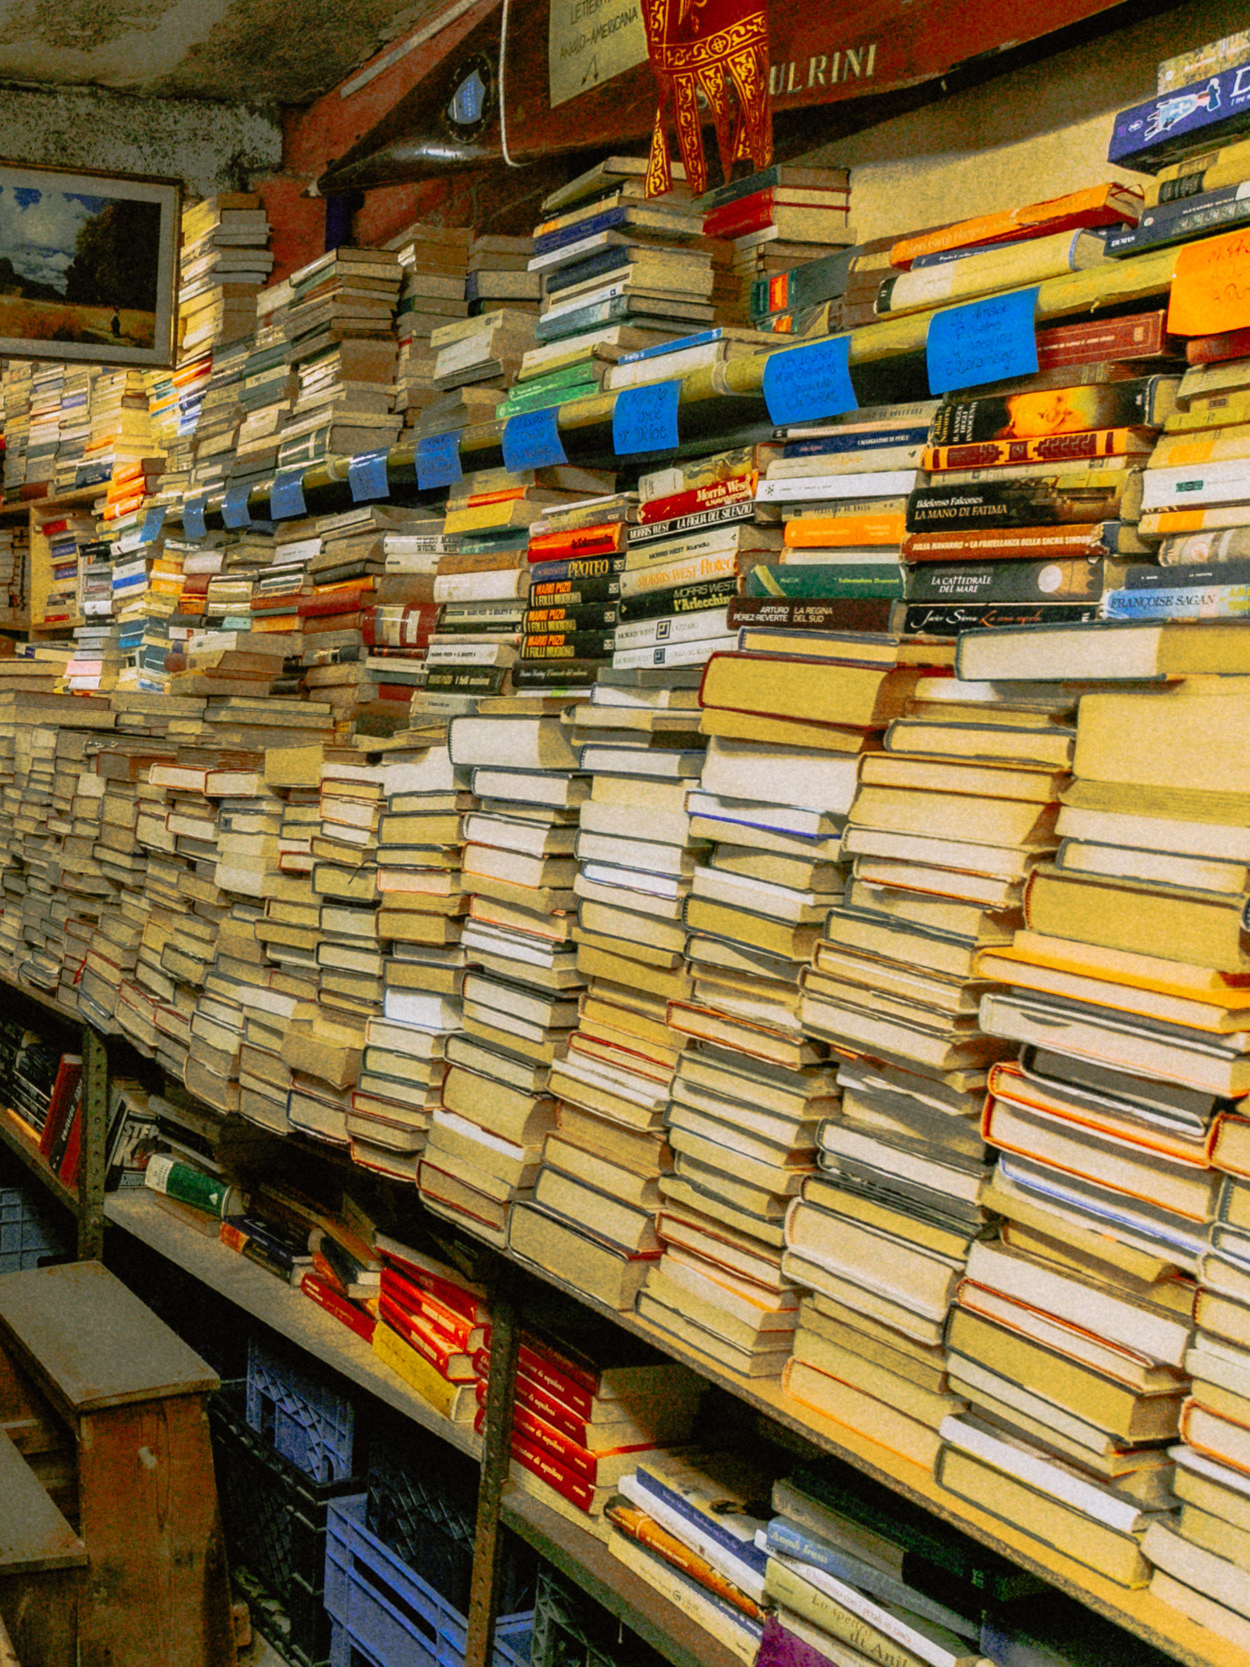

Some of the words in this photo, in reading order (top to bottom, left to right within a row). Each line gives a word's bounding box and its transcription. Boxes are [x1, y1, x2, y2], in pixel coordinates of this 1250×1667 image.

[696, 484, 727, 503] Morris
[950, 496, 984, 507] Falcones
[914, 509, 927, 520] LA
[927, 508, 958, 520] MANO
[958, 506, 971, 516] DI
[971, 504, 1008, 516] FATIMA
[630, 526, 652, 539] MORRIS
[652, 522, 670, 535] WEST
[676, 519, 686, 531] LA
[686, 515, 707, 528] FIGLIA
[708, 511, 720, 523] DEL
[721, 502, 753, 520] SILENZIO
[931, 541, 963, 550] NAVARRO
[1042, 535, 1064, 546] SACRA
[649, 551, 669, 560] MORRIS
[669, 547, 684, 556] WEST
[568, 560, 609, 578] PROTEO
[637, 572, 671, 588] MORRIS
[671, 565, 698, 581] WEST
[931, 576, 941, 586] LA
[941, 574, 992, 586] CATTEDRALE
[536, 583, 555, 596] MARIO
[555, 581, 572, 594] PUZO
[673, 584, 709, 600] MORRIS
[709, 580, 737, 594] WEST
[939, 585, 954, 593] DEL
[955, 585, 980, 593] MARE
[673, 593, 731, 612] l'Arlecchin
[1111, 596, 1174, 611] FRANÇOISE
[1175, 594, 1216, 607] SAGAN
[528, 610, 548, 623] MARIO
[549, 608, 566, 621] PUZO
[733, 613, 789, 623] PÉREZ-REVERTE
[760, 606, 789, 615] ARTURO
[793, 606, 806, 616] LA
[807, 606, 833, 616] REGINA
[793, 614, 808, 623] DEL
[809, 614, 825, 623] SUD
[527, 636, 548, 647] MARIO
[548, 634, 565, 647] PUZO
[812, 1592, 829, 1611] Lo
[850, 1630, 865, 1649] di
[871, 1642, 908, 1667] Anil
